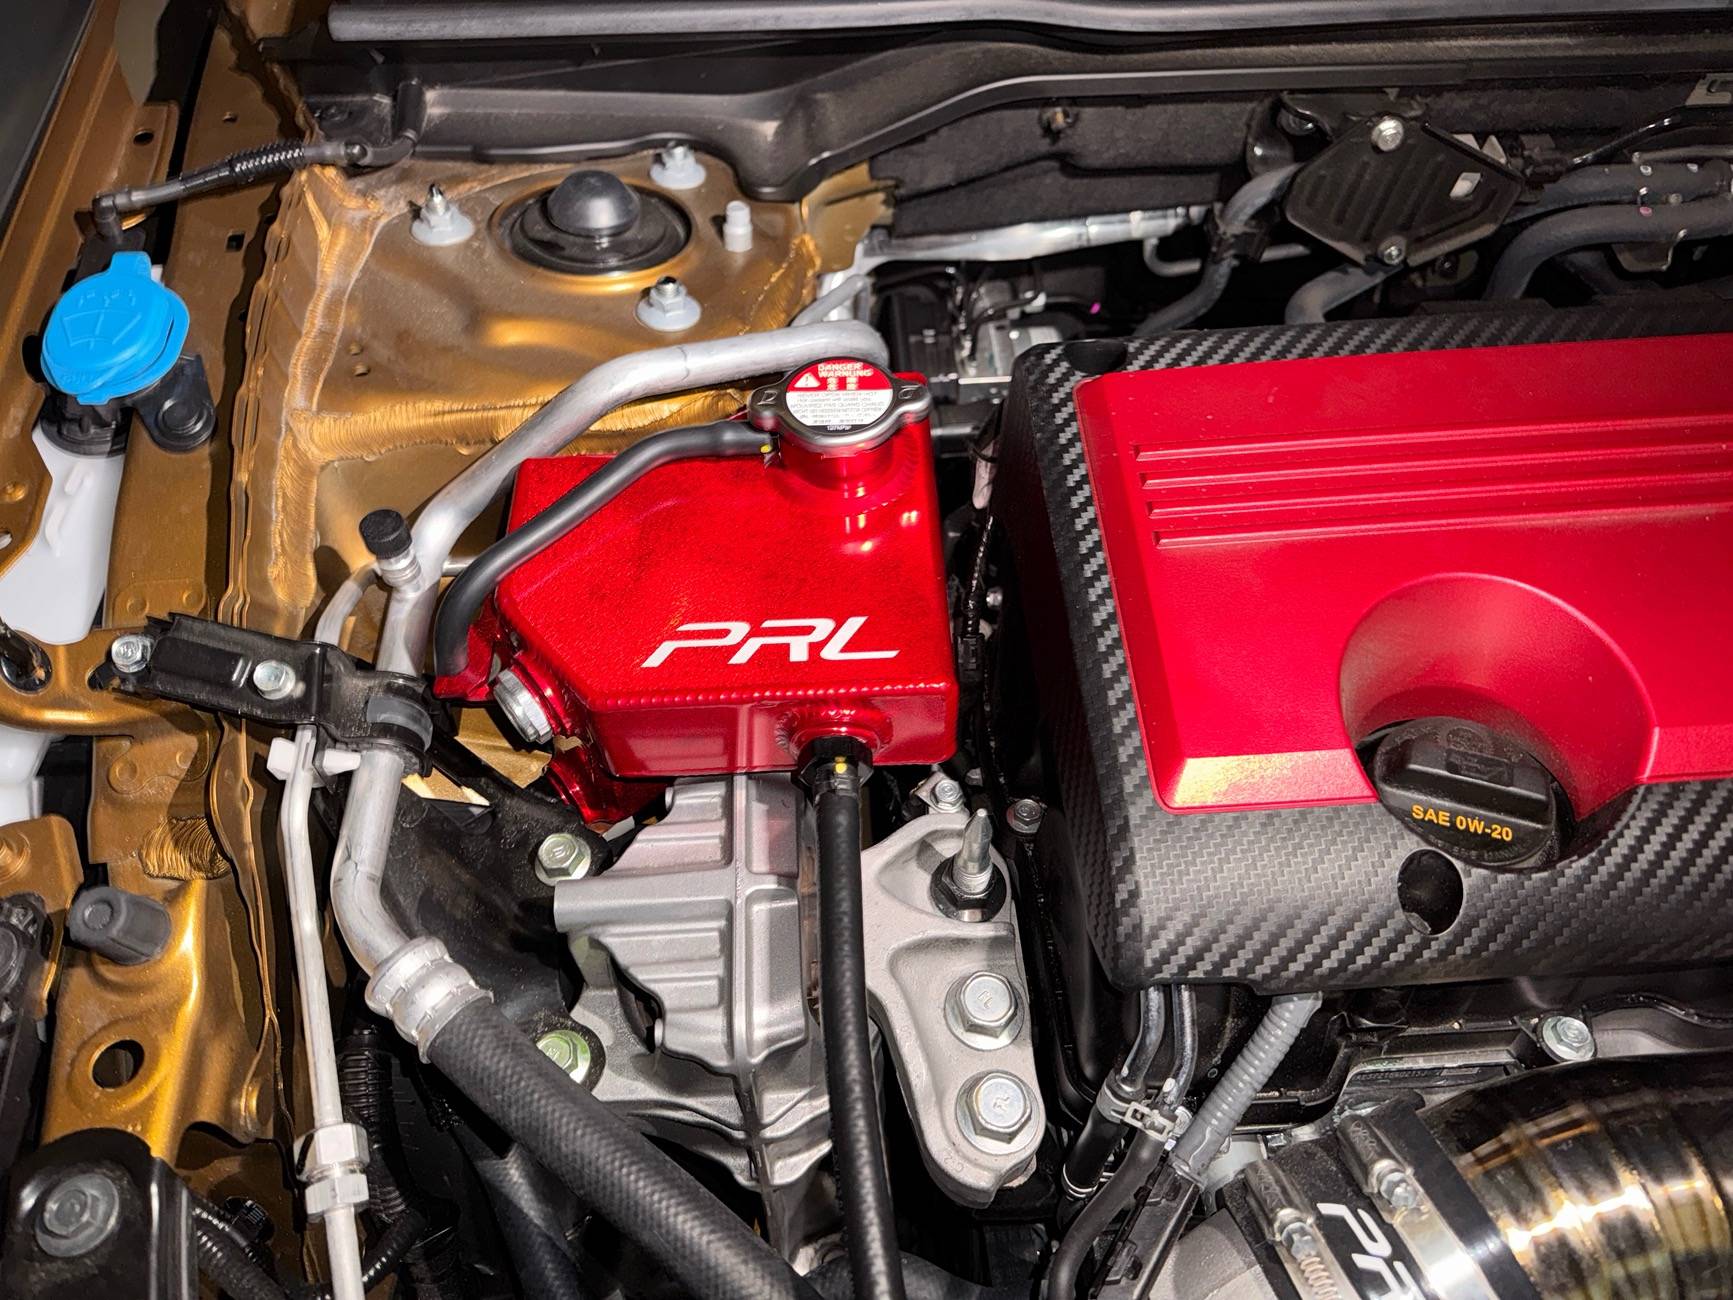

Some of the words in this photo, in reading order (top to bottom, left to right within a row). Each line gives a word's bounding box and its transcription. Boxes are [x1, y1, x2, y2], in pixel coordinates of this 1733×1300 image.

[818, 362, 864, 371] DANGER
[640, 615, 900, 668] PRL
[1411, 804, 1451, 827] SAE
[1455, 815, 1513, 842] 0W-20
